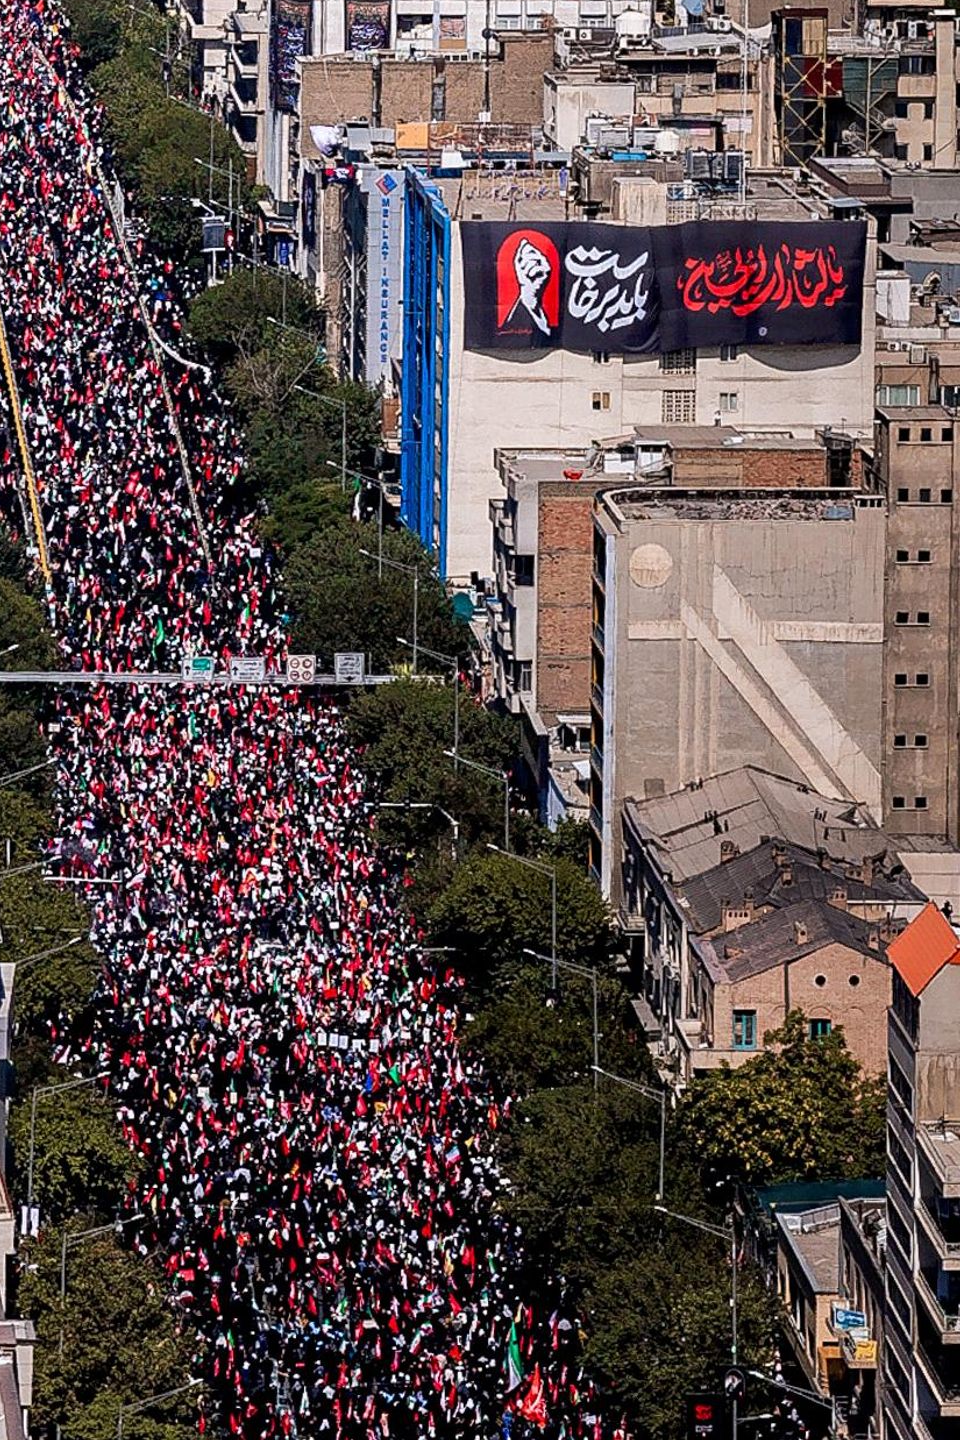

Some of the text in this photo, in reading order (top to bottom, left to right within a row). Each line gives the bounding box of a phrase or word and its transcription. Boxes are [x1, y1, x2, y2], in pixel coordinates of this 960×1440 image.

[380, 197, 390, 363] MELLAT INSURANCE
[564, 245, 650, 333] باید برخاست
